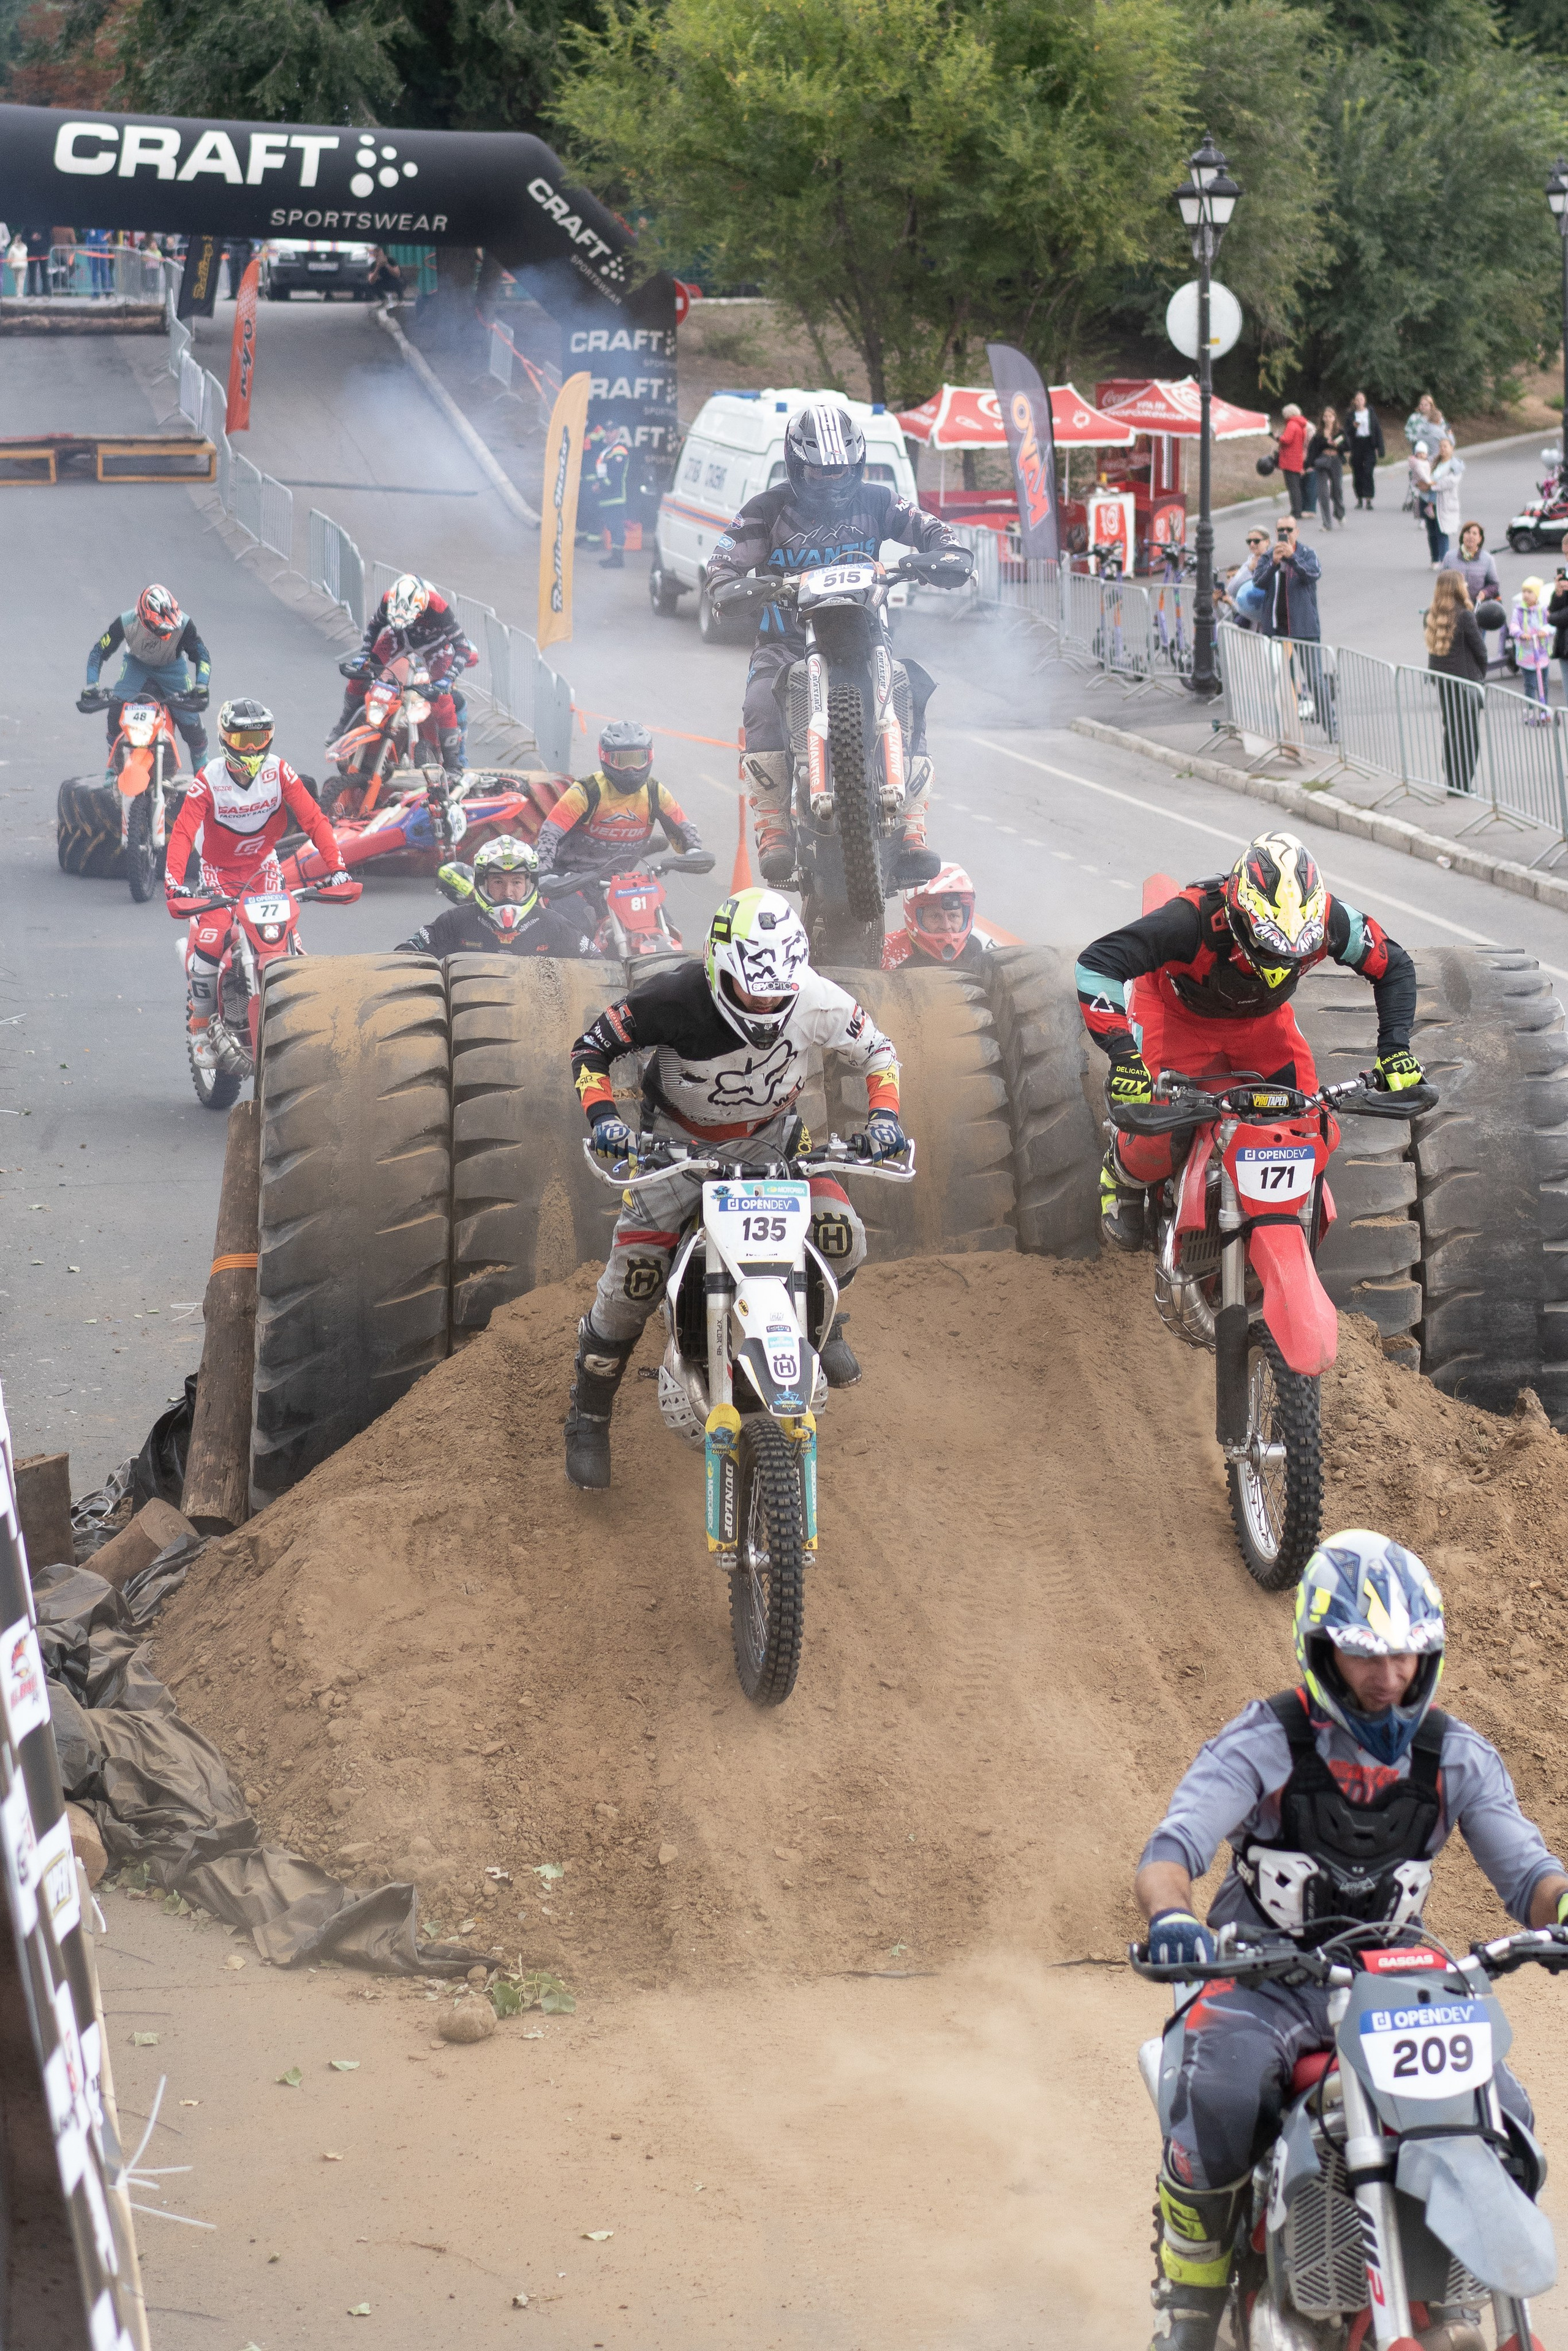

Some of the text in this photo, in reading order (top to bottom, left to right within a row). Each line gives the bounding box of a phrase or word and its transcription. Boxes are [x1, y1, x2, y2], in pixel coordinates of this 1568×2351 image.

[54, 122, 339, 186] CRAFT
[270, 209, 448, 232] SPORTSWEAR
[527, 177, 612, 258] CRAFT
[570, 330, 664, 353] CRAFT
[589, 377, 664, 400] RAFT
[618, 426, 665, 448] AFT
[767, 537, 876, 568] AVANTIS
[823, 572, 861, 587] 515
[876, 651, 886, 689] MAXIMA
[811, 673, 821, 711] MAXIMA
[133, 712, 147, 721] 48
[809, 735, 820, 787] AVANTIS
[219, 796, 277, 814] GASGAS
[589, 825, 646, 837] VECTOR
[261, 904, 279, 916] 77
[631, 897, 646, 911] 81
[1255, 924, 1287, 953] Airoh
[1299, 924, 1323, 953] Airoh
[1381, 1051, 1409, 1065] DELICATE
[1392, 1056, 1420, 1072] FOX
[1116, 1065, 1147, 1076] DELICATE
[1111, 1077, 1148, 1095] FOX
[1257, 1149, 1305, 1160] OPENDEV
[1261, 1166, 1295, 1189] 171
[741, 1199, 790, 1210] OPENDEV
[743, 1217, 787, 1242] 135
[717, 1345, 722, 1356] 48
[725, 1462, 734, 1538] DUNLOP
[1378, 1954, 1434, 1968] GASGAS
[1393, 2006, 1471, 2028] OPENDEV
[1393, 2034, 1474, 2078] 209
